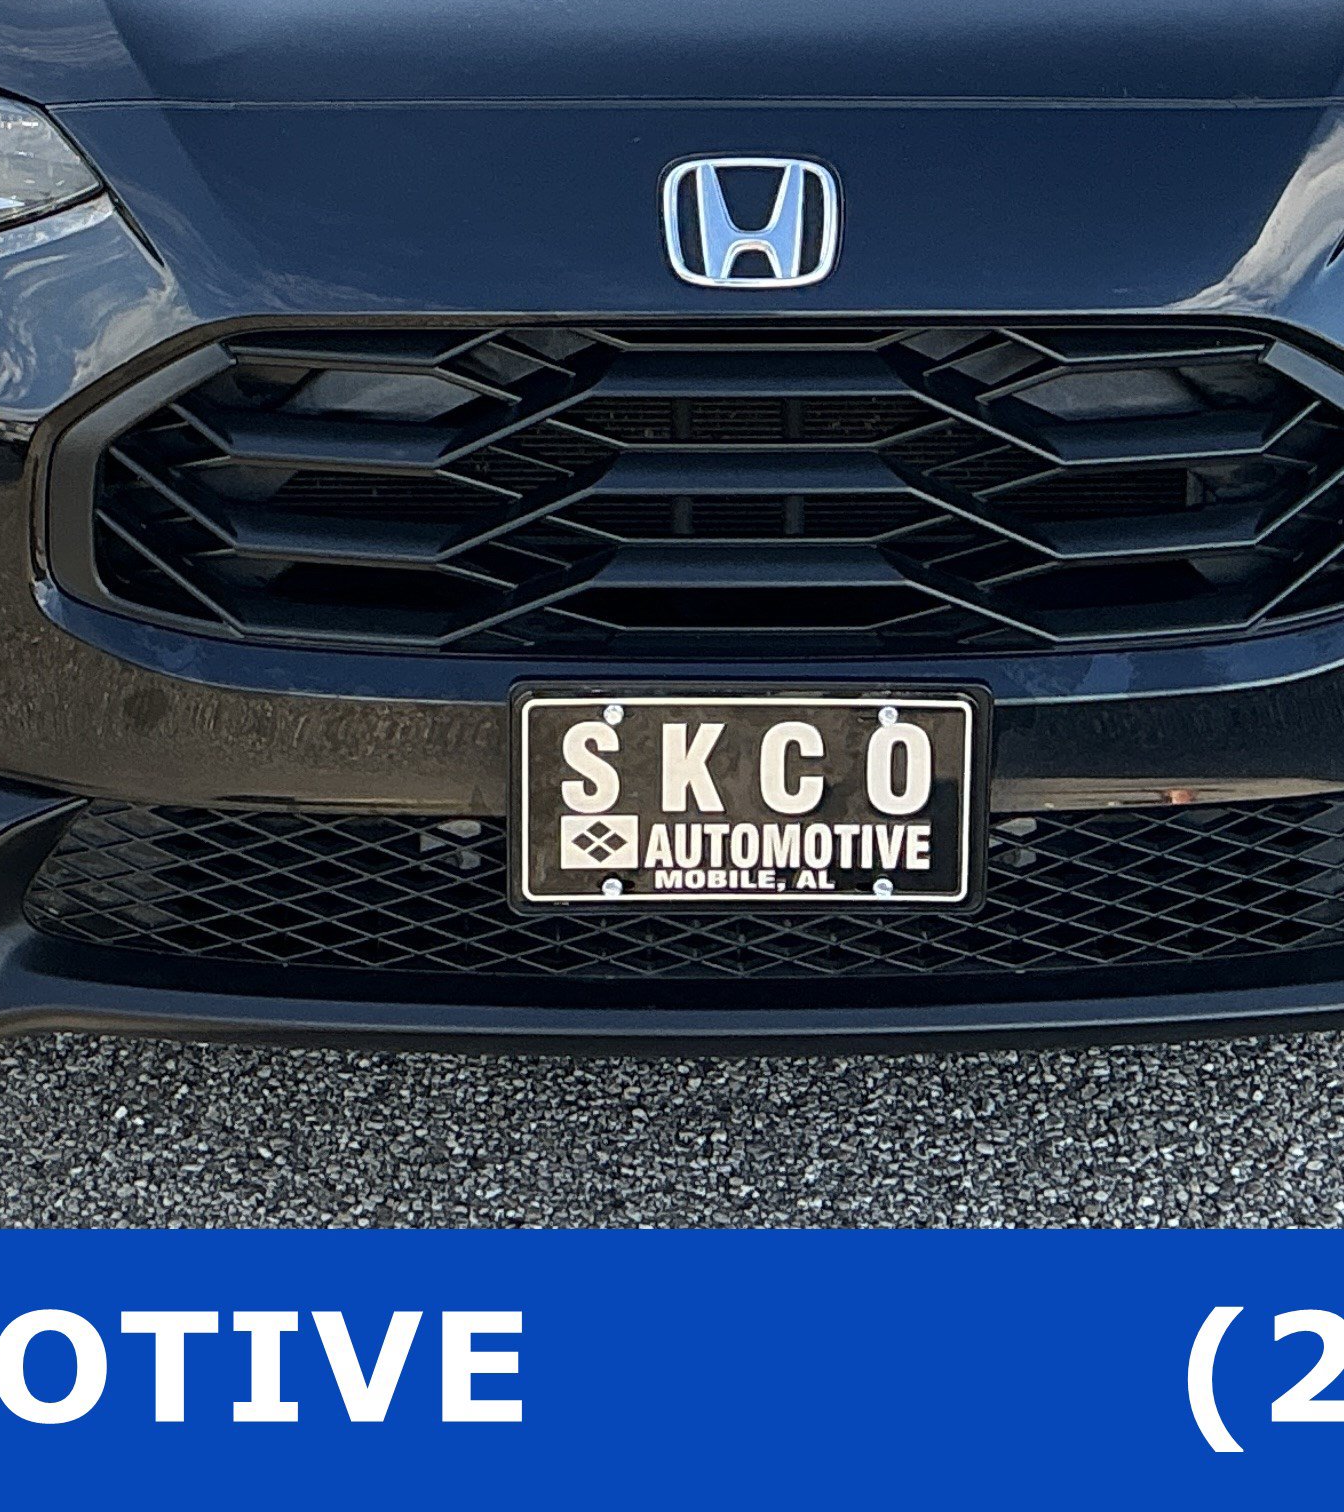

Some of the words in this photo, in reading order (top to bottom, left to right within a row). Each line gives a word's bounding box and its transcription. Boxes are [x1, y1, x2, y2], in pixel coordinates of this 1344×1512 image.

[560, 720, 932, 815] SKCO
[644, 822, 931, 870] AUTOMOTIVE
[655, 870, 786, 892] MOBILE,
[795, 870, 836, 890] AL
